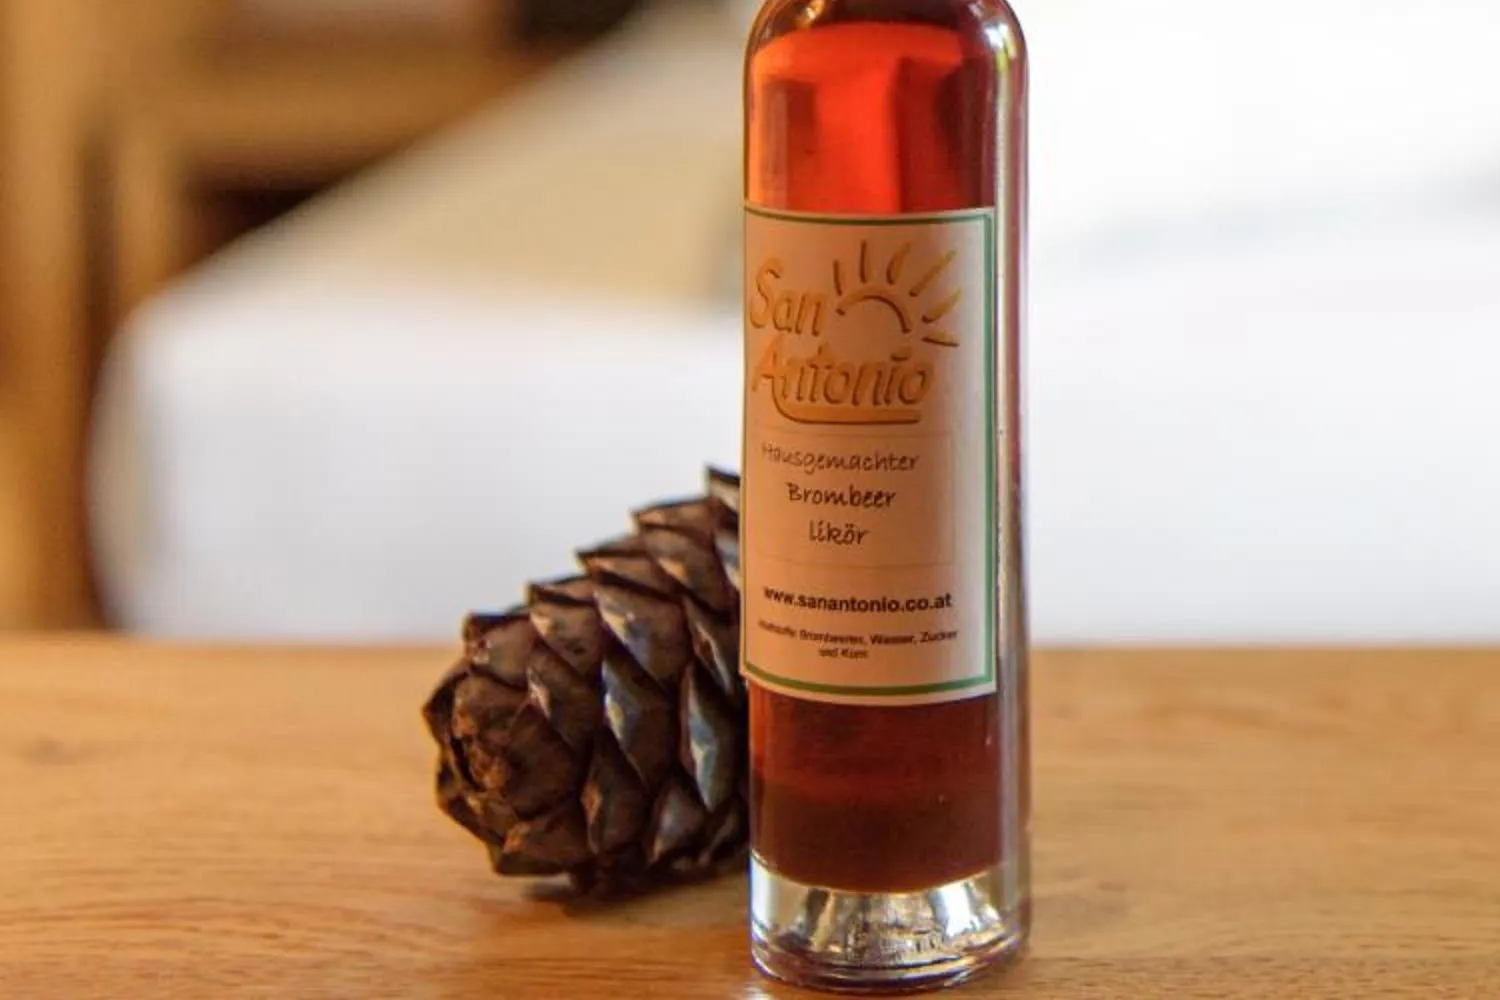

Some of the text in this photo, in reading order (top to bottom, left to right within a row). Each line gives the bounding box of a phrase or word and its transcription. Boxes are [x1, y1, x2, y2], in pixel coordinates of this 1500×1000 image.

[749, 257, 829, 337] San
[752, 334, 933, 407] Antonio
[761, 441, 920, 475] Hausgemachter
[785, 482, 897, 509] Brombeer
[763, 586, 952, 613] www.sanantonio.co.at
